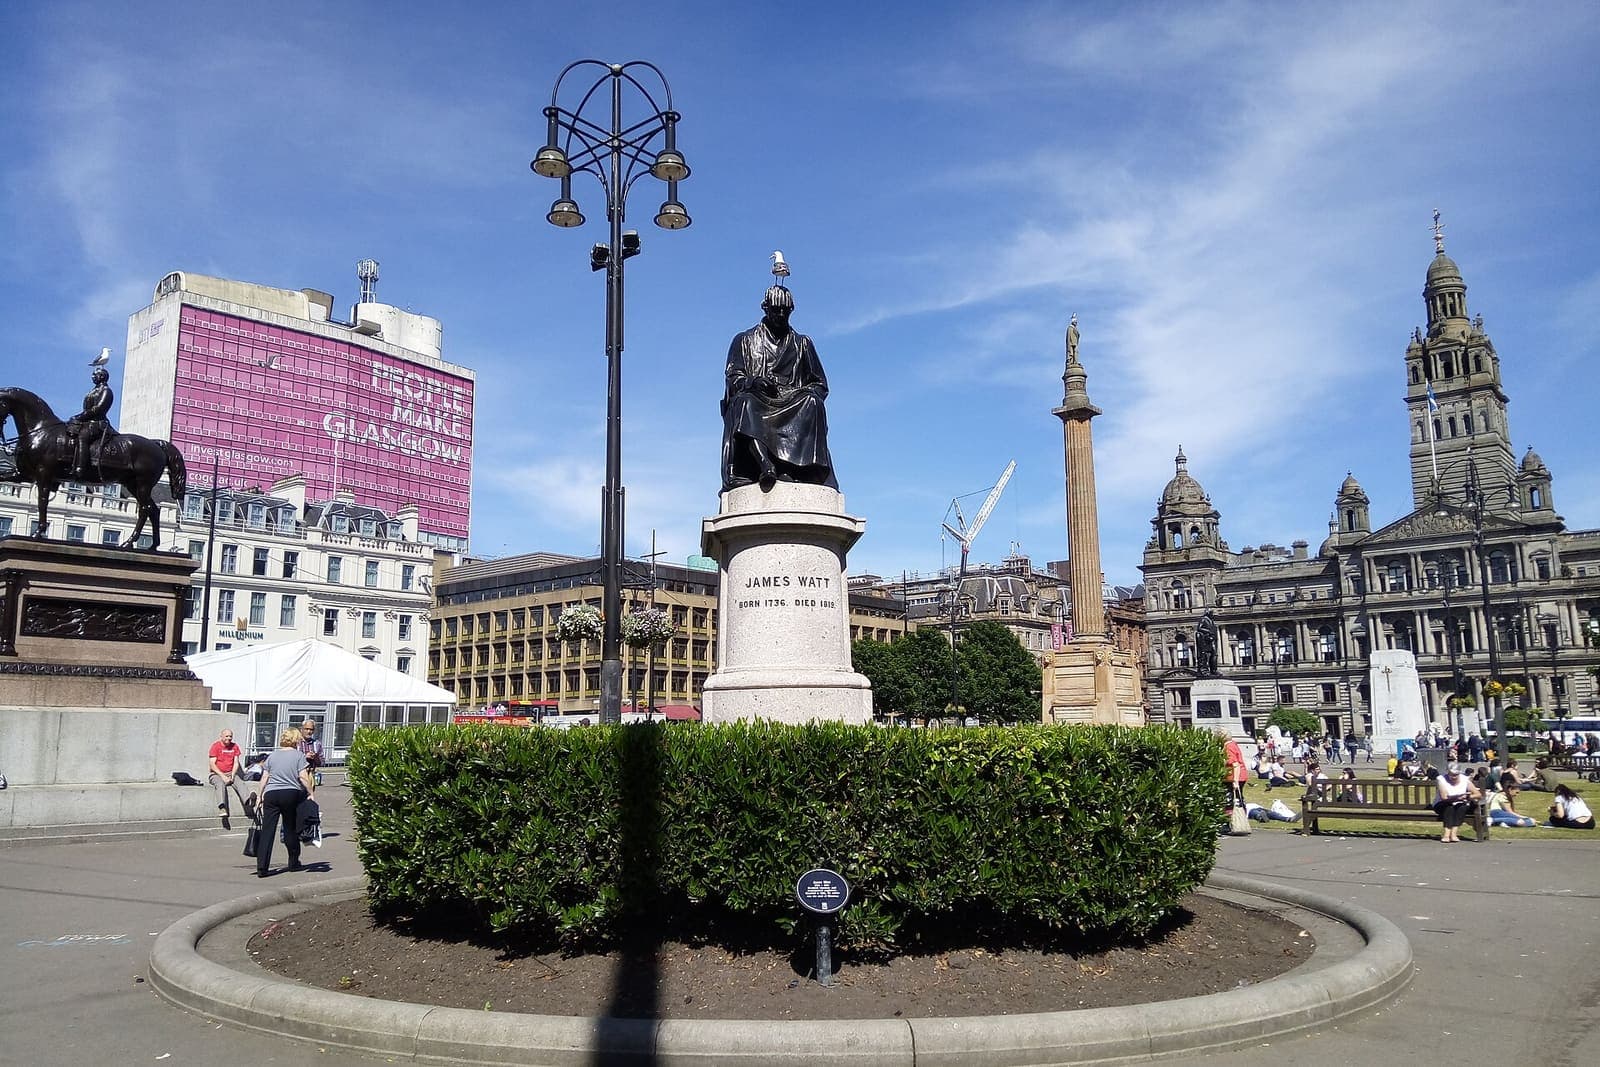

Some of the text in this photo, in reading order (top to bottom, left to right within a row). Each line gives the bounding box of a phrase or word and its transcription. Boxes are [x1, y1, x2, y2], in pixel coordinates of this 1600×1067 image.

[371, 361, 464, 411] PEOPLE
[393, 398, 464, 438] MAKE
[323, 410, 462, 466] GLASGOW
[191, 444, 294, 468] investglasgow.com
[745, 576, 830, 588] JAMES WATT
[739, 600, 760, 608] BORN
[795, 599, 816, 607] DIED
[218, 630, 264, 640] MILLENNIUM
